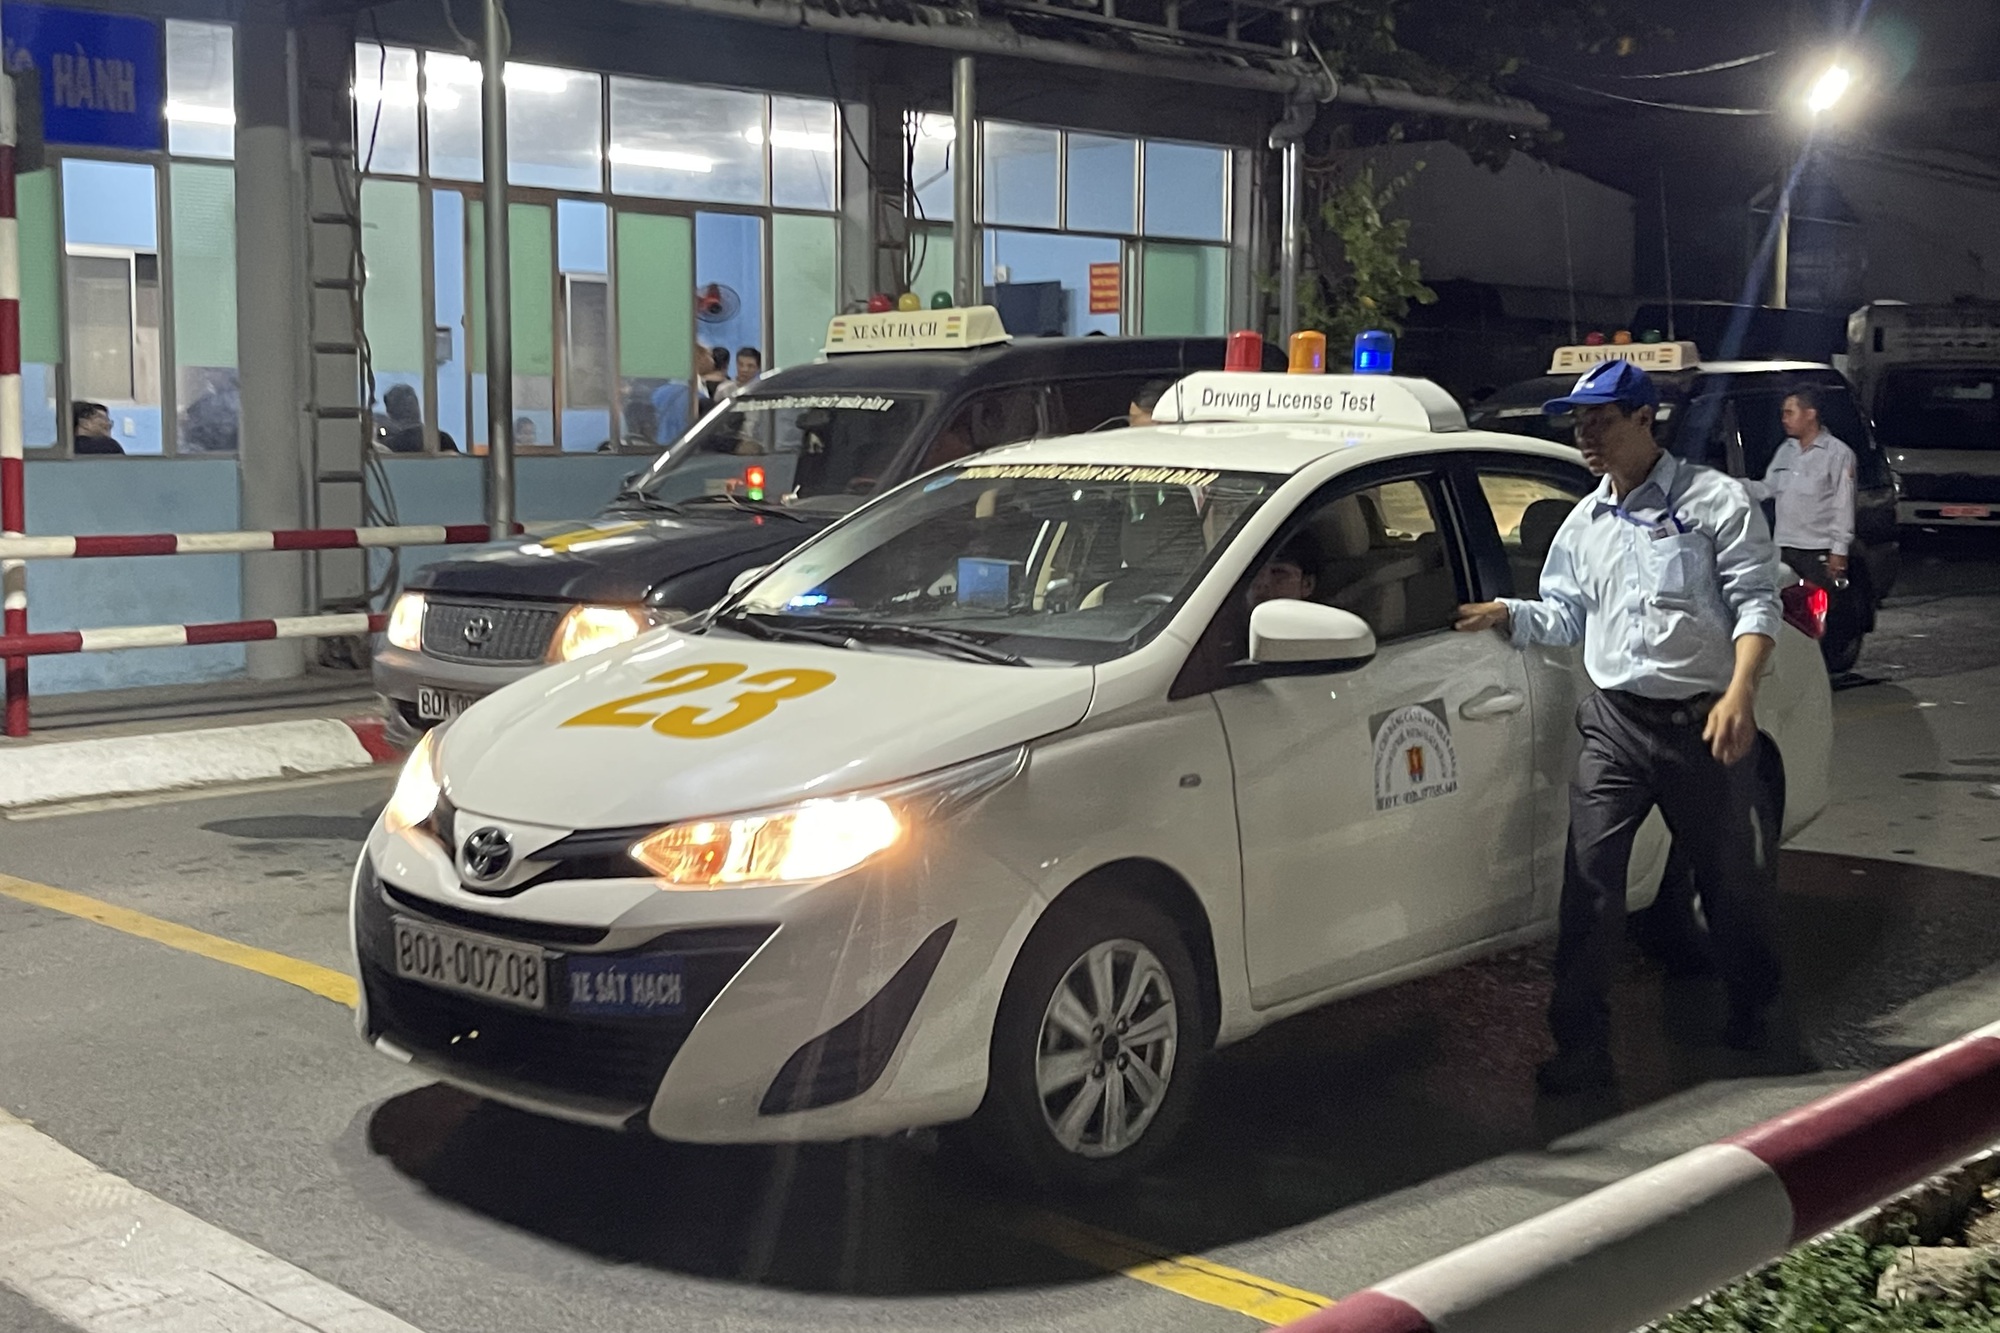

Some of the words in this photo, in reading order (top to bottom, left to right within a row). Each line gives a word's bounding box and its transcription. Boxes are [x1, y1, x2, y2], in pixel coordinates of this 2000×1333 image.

[53, 41, 136, 114] HÀNH
[852, 325, 868, 339] XE
[871, 318, 895, 339] SÁT
[1202, 387, 1262, 412] Driving
[1266, 388, 1332, 410] License
[1340, 391, 1375, 412] Test
[556, 662, 837, 739] 23
[399, 929, 540, 1001] 80A-007.08
[570, 971, 594, 1003] XE
[595, 964, 628, 1005] SÁT
[630, 972, 682, 1009] HẠCH
